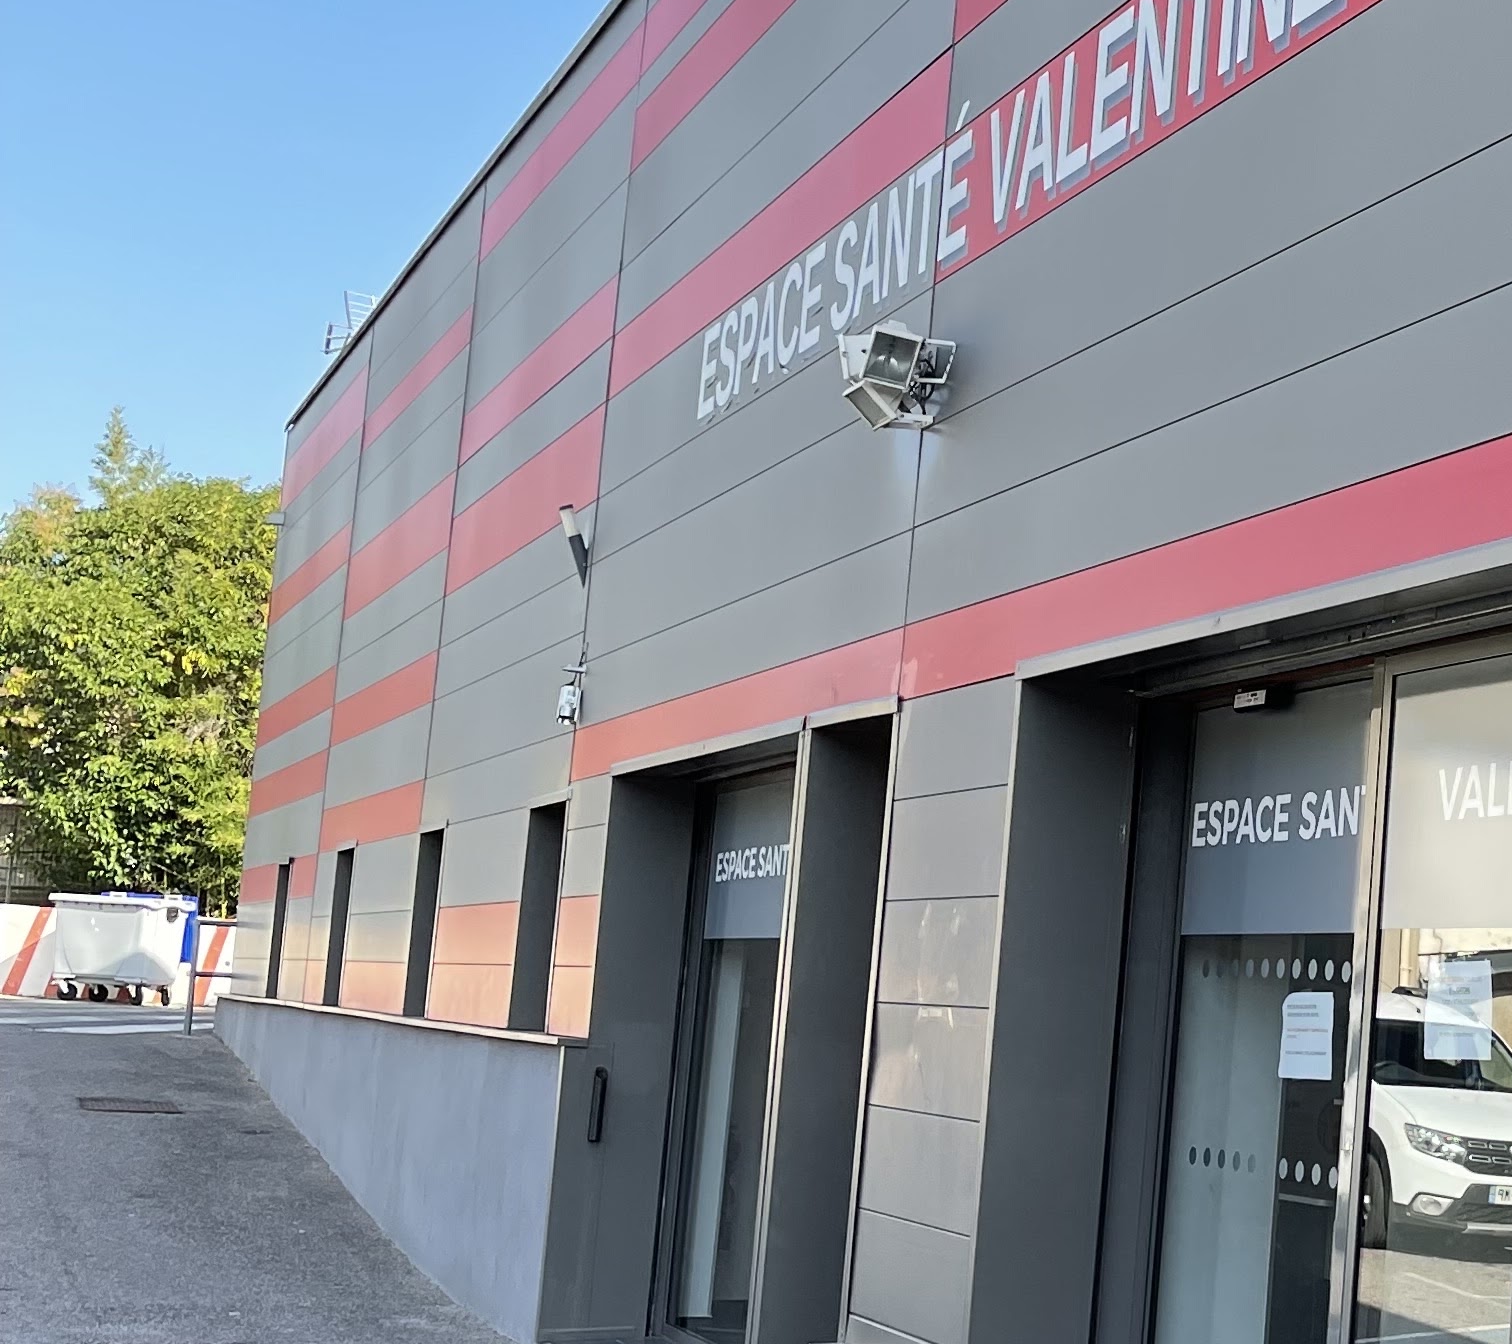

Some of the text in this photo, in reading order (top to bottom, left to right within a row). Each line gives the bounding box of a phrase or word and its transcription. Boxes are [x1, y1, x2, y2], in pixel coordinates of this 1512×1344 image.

[697, 241, 827, 420] ESPACE
[830, 100, 972, 331] SANTÉ
[1191, 784, 1367, 847] ESPACE SAN
[715, 844, 791, 883] ESPACE SANT
